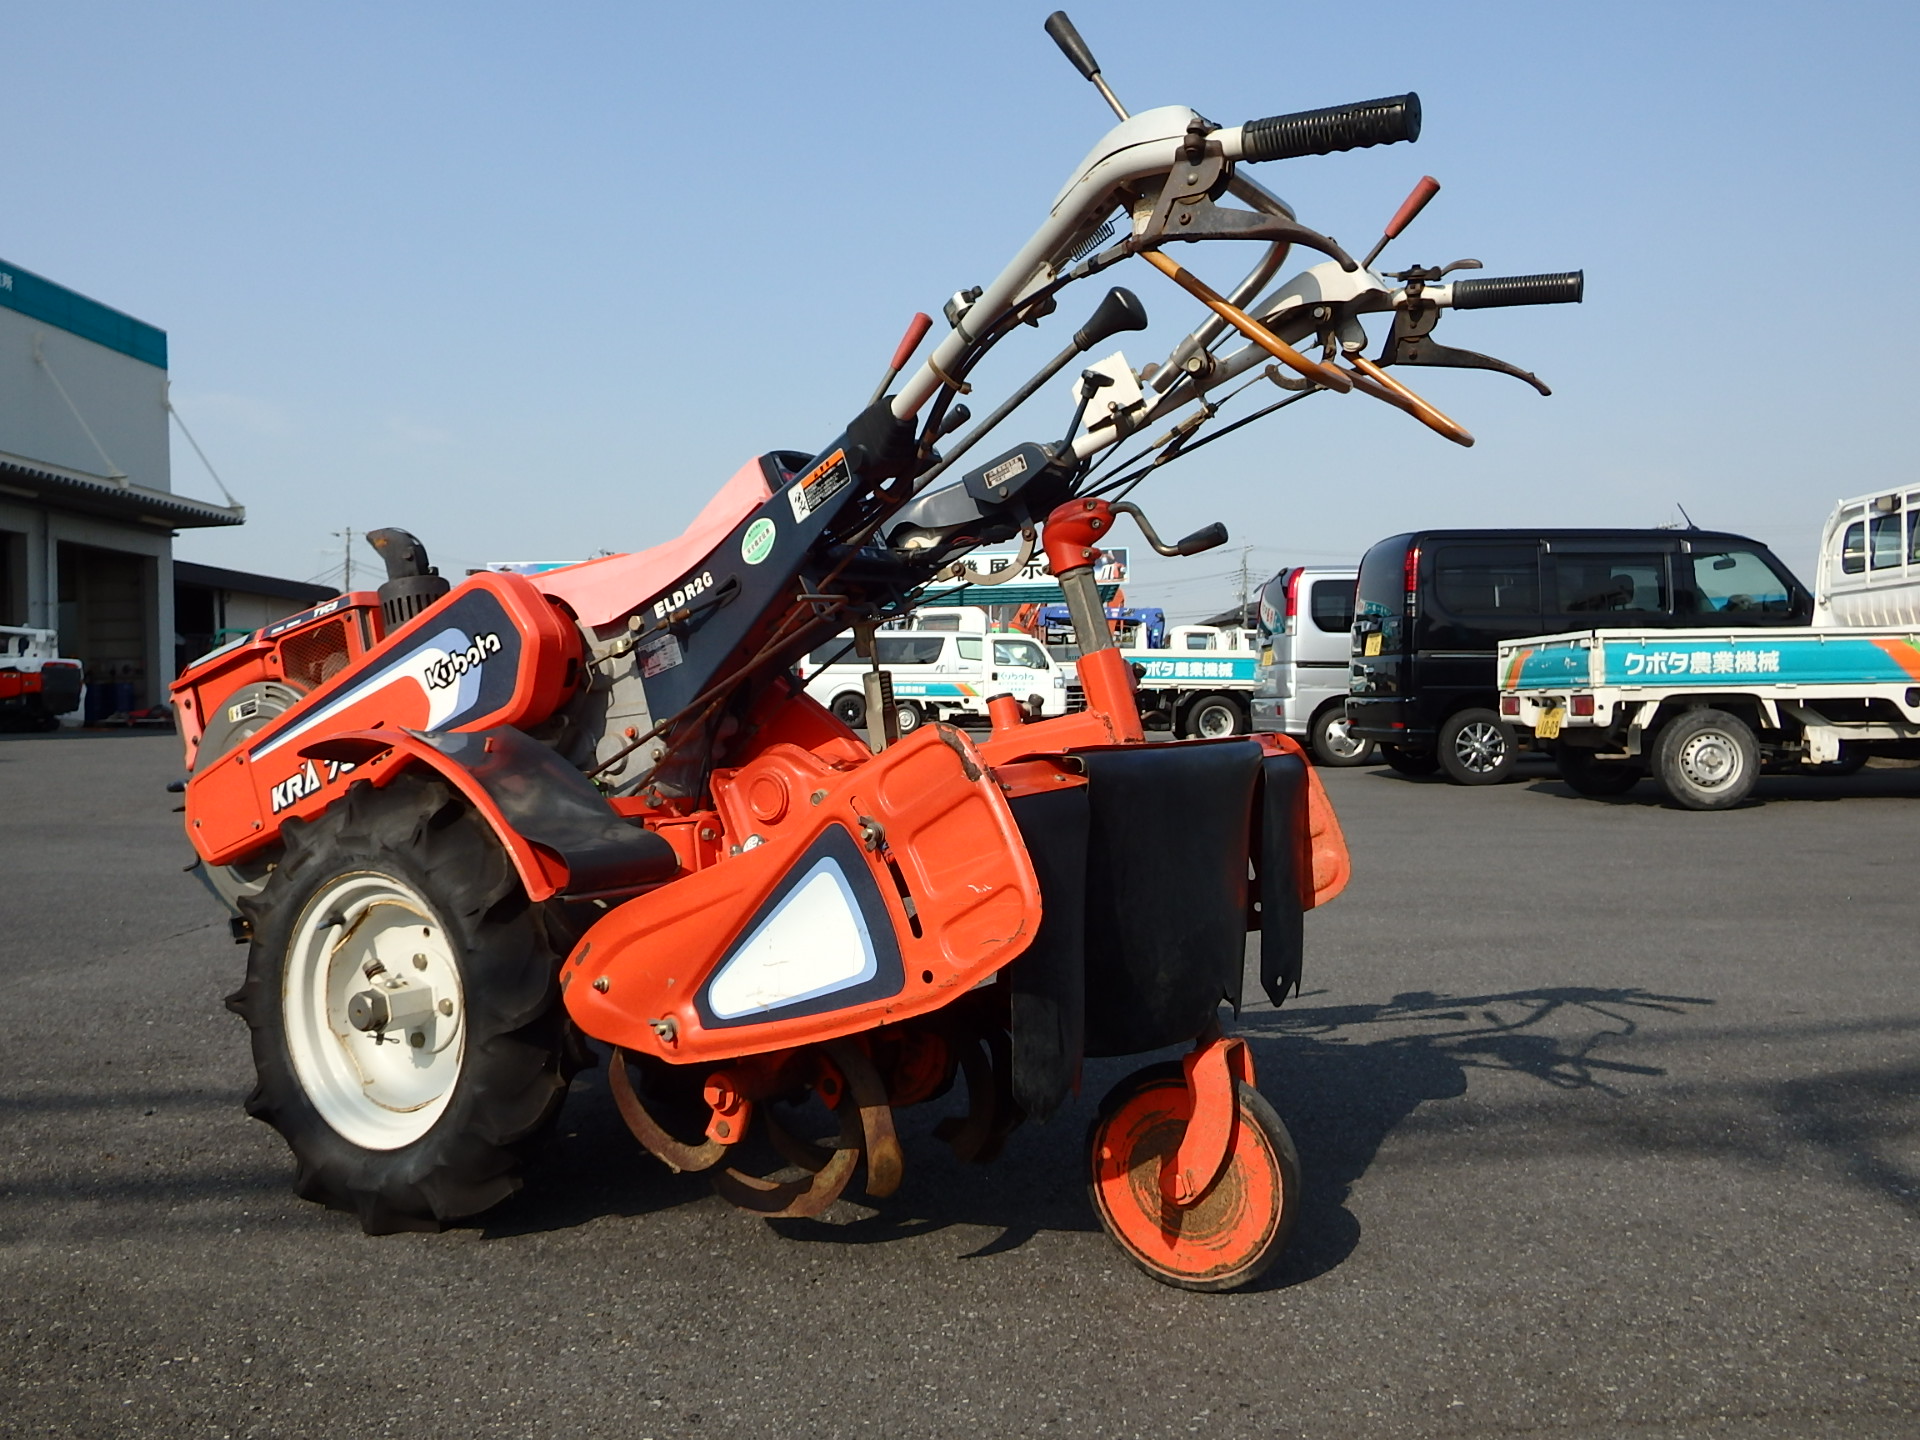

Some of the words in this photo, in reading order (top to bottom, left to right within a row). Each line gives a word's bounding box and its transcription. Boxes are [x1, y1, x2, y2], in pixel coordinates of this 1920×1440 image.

[425, 632, 501, 689] Kubota
[1141, 661, 1234, 678] ボタ農業機械
[1624, 650, 1780, 675] クボタ農業機械
